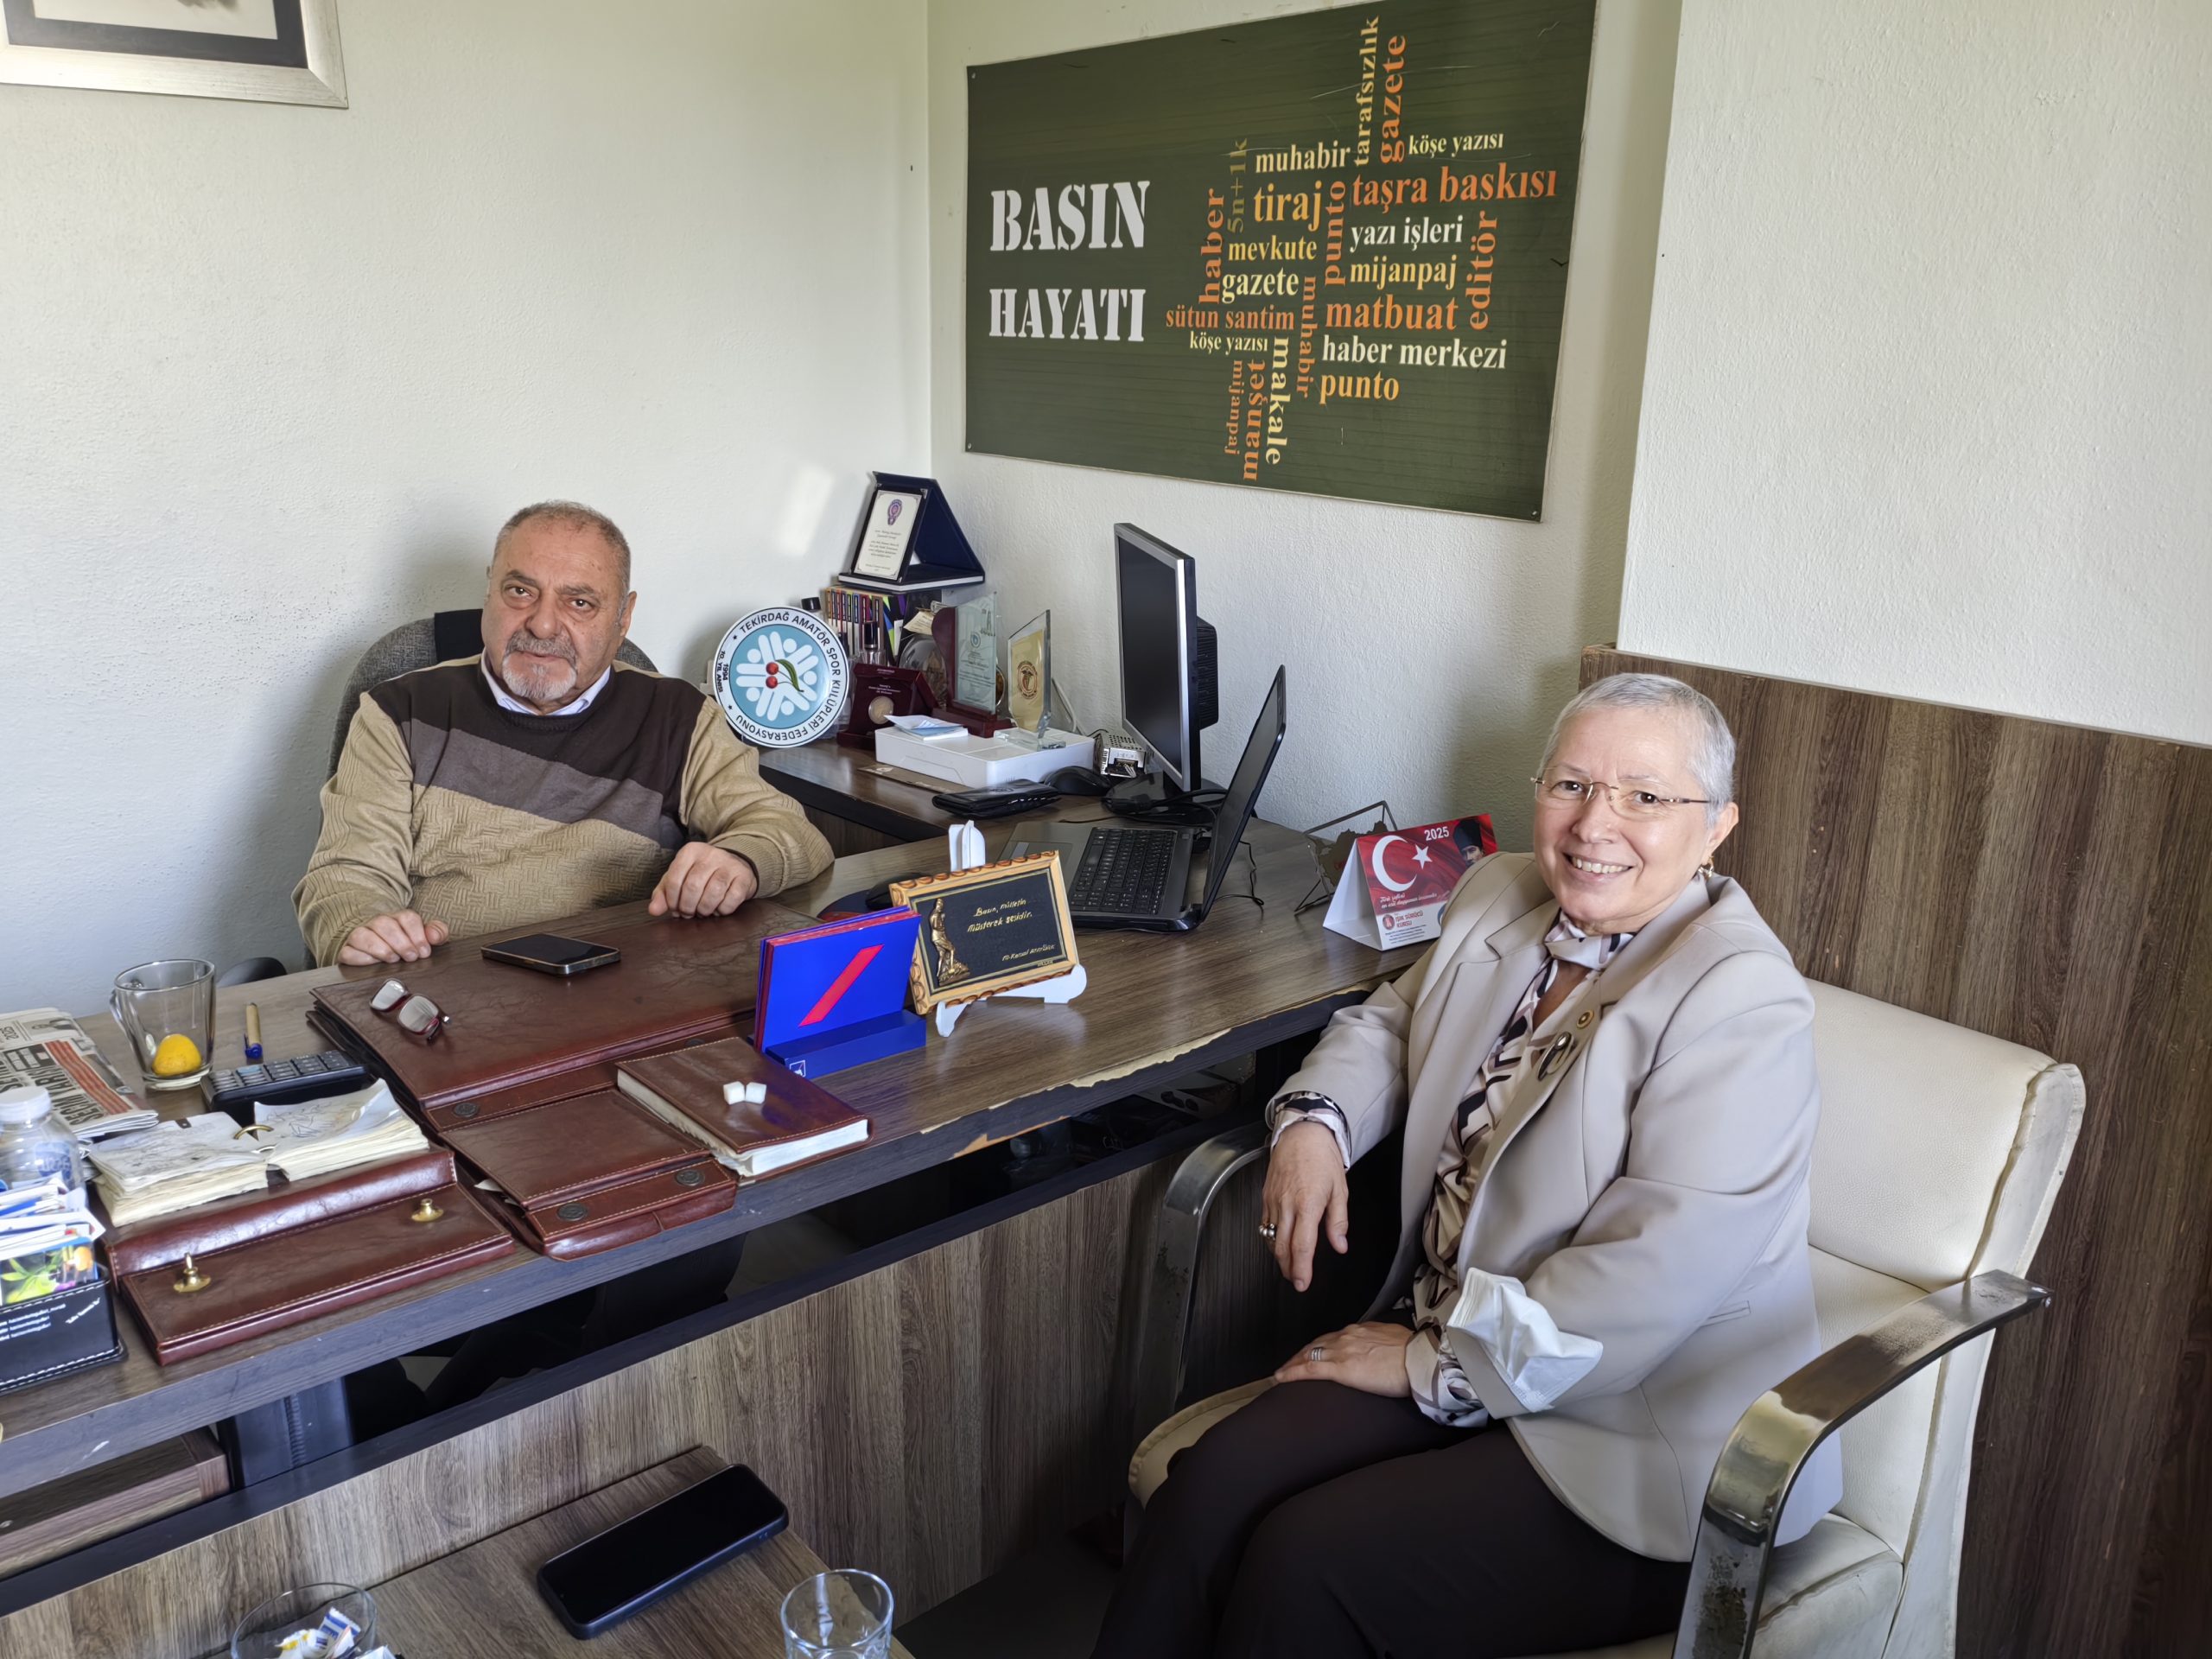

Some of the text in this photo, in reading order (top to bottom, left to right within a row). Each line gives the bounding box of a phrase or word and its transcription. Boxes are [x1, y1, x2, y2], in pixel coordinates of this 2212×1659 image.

[1353, 16, 1380, 166] tarafsızlık
[1381, 35, 1407, 163] gazete
[1255, 140, 1351, 173] muhabir
[1408, 133, 1503, 158] köşe yazısı
[1227, 137, 1248, 233] 5n+1k
[1254, 180, 1322, 232] tiraj
[1351, 162, 1557, 213] taşra baskısı
[990, 181, 1150, 251] BASIN
[1325, 181, 1346, 286] punto
[1350, 215, 1463, 252] yazı işleri
[1198, 188, 1224, 304] haber
[1228, 235, 1317, 261] mevkute
[1350, 254, 1457, 290] mijanpaj
[1465, 210, 1497, 331] editör
[1221, 268, 1299, 303] gazete
[989, 289, 1146, 341] HAYATI
[1166, 304, 1294, 330] sütun santim
[1296, 276, 1318, 398] muhabir
[1325, 294, 1459, 330] matbuat
[1190, 331, 1268, 355] köşe yazısı
[1322, 334, 1507, 369] haber merkezi
[1224, 359, 1244, 455] mijanpaj
[1265, 335, 1291, 465] makale
[1319, 371, 1399, 404] punto
[1243, 359, 1268, 480] manşet
[735, 611, 842, 741] TEKİRDAĞ AMATÖR SPOR KULÜPLERİ FEDERASYONU
[1424, 826, 1450, 842] 2025
